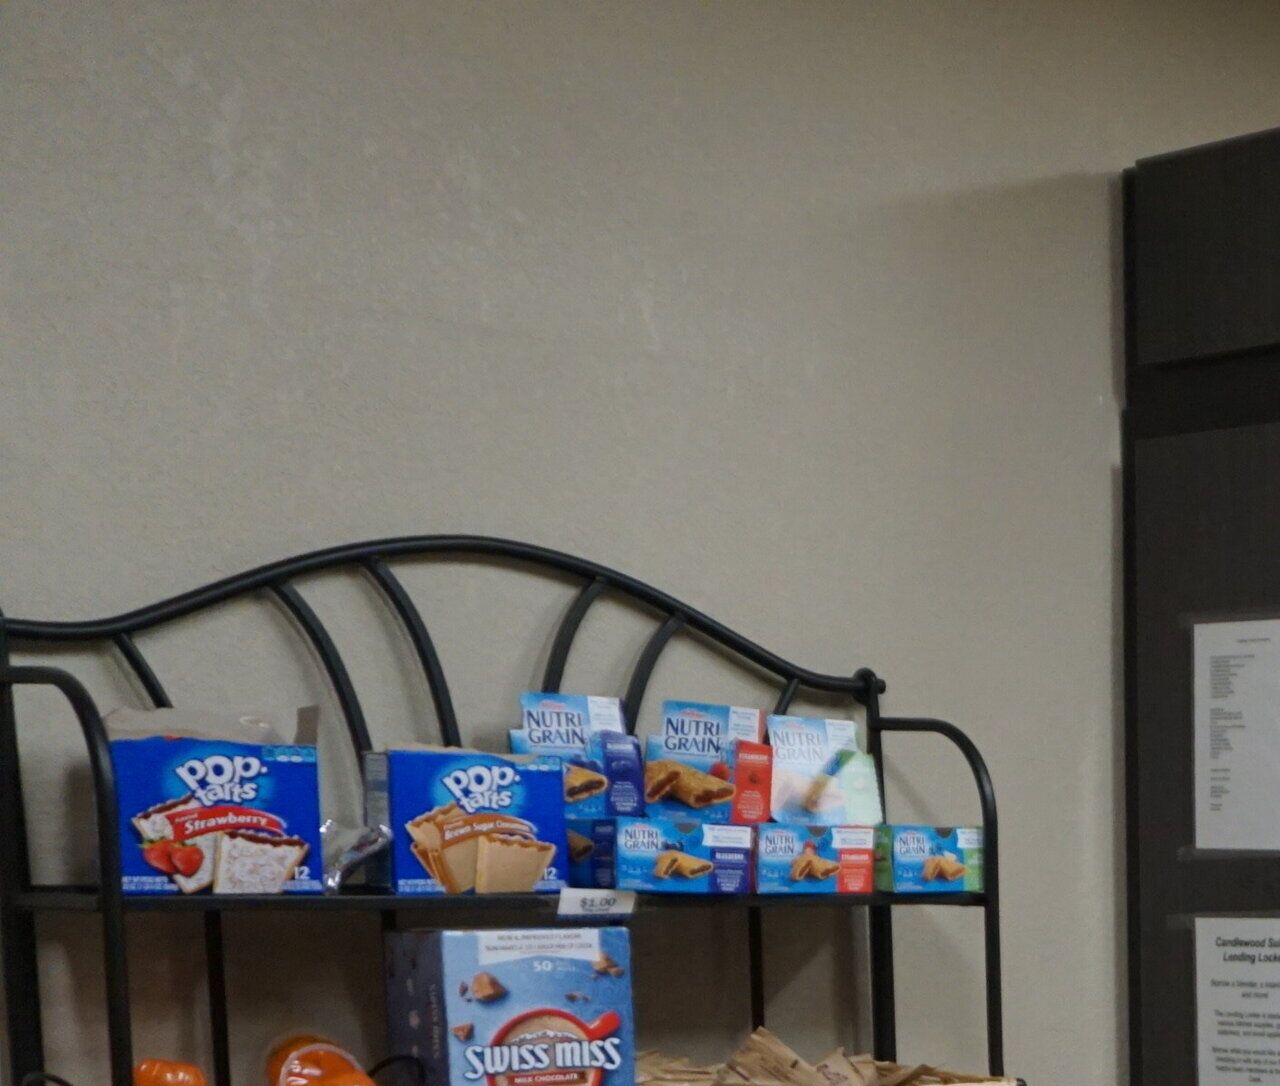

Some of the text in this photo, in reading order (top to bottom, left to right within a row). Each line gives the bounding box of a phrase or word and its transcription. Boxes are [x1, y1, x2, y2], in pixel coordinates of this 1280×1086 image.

[527, 710, 583, 729] NUTRI
[665, 717, 721, 737] NUTRI
[528, 728, 585, 745] GRAIN
[664, 736, 721, 754] GRAIN
[184, 812, 268, 835] Strawberry
[294, 866, 311, 880] 12
[543, 867, 557, 880] 12
[1215, 936, 1266, 948] Candlewood
[1223, 951, 1256, 965] Lending
[514, 1072, 579, 1085] MILK CHOCOLATE
